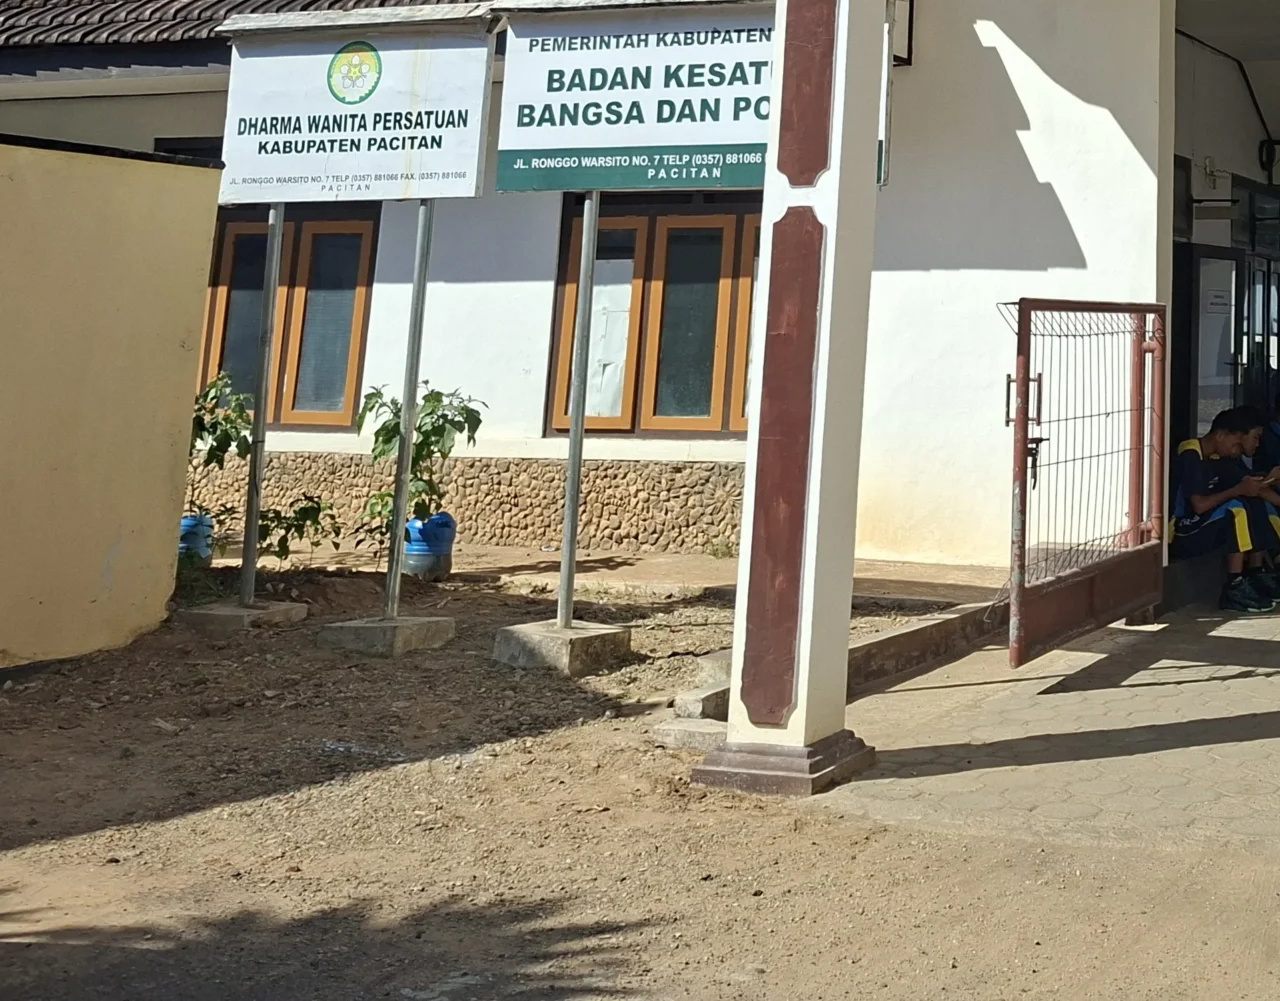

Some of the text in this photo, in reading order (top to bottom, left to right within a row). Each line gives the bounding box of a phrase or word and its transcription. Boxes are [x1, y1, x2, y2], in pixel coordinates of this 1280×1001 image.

[528, 27, 772, 53] PEMERINTAH KABUPATEN
[547, 60, 773, 93] BADAN KESAT
[237, 109, 469, 136] DHARMA WANITA PERSATUAN
[517, 101, 645, 128] BANGSA
[656, 97, 721, 123] DAN
[258, 135, 443, 155] KABUPATEN PACITAN
[513, 159, 529, 169] JL.
[531, 157, 579, 169] RONGGO
[580, 156, 630, 168] WARSITO
[632, 155, 651, 166] NO.
[653, 155, 661, 165] 7
[662, 154, 690, 165] TELP
[691, 154, 723, 167] (0357)
[725, 153, 762, 164] 881066
[229, 178, 240, 186] JL.
[241, 176, 275, 185] RONGGO
[276, 175, 309, 184] WARSITO
[310, 175, 324, 183] NO.
[331, 174, 350, 183] TELP
[351, 173, 373, 183] (0357)
[374, 172, 399, 181] 881066
[400, 172, 417, 181] FAX.
[418, 171, 440, 181] (0357)
[441, 171, 467, 180] 881066
